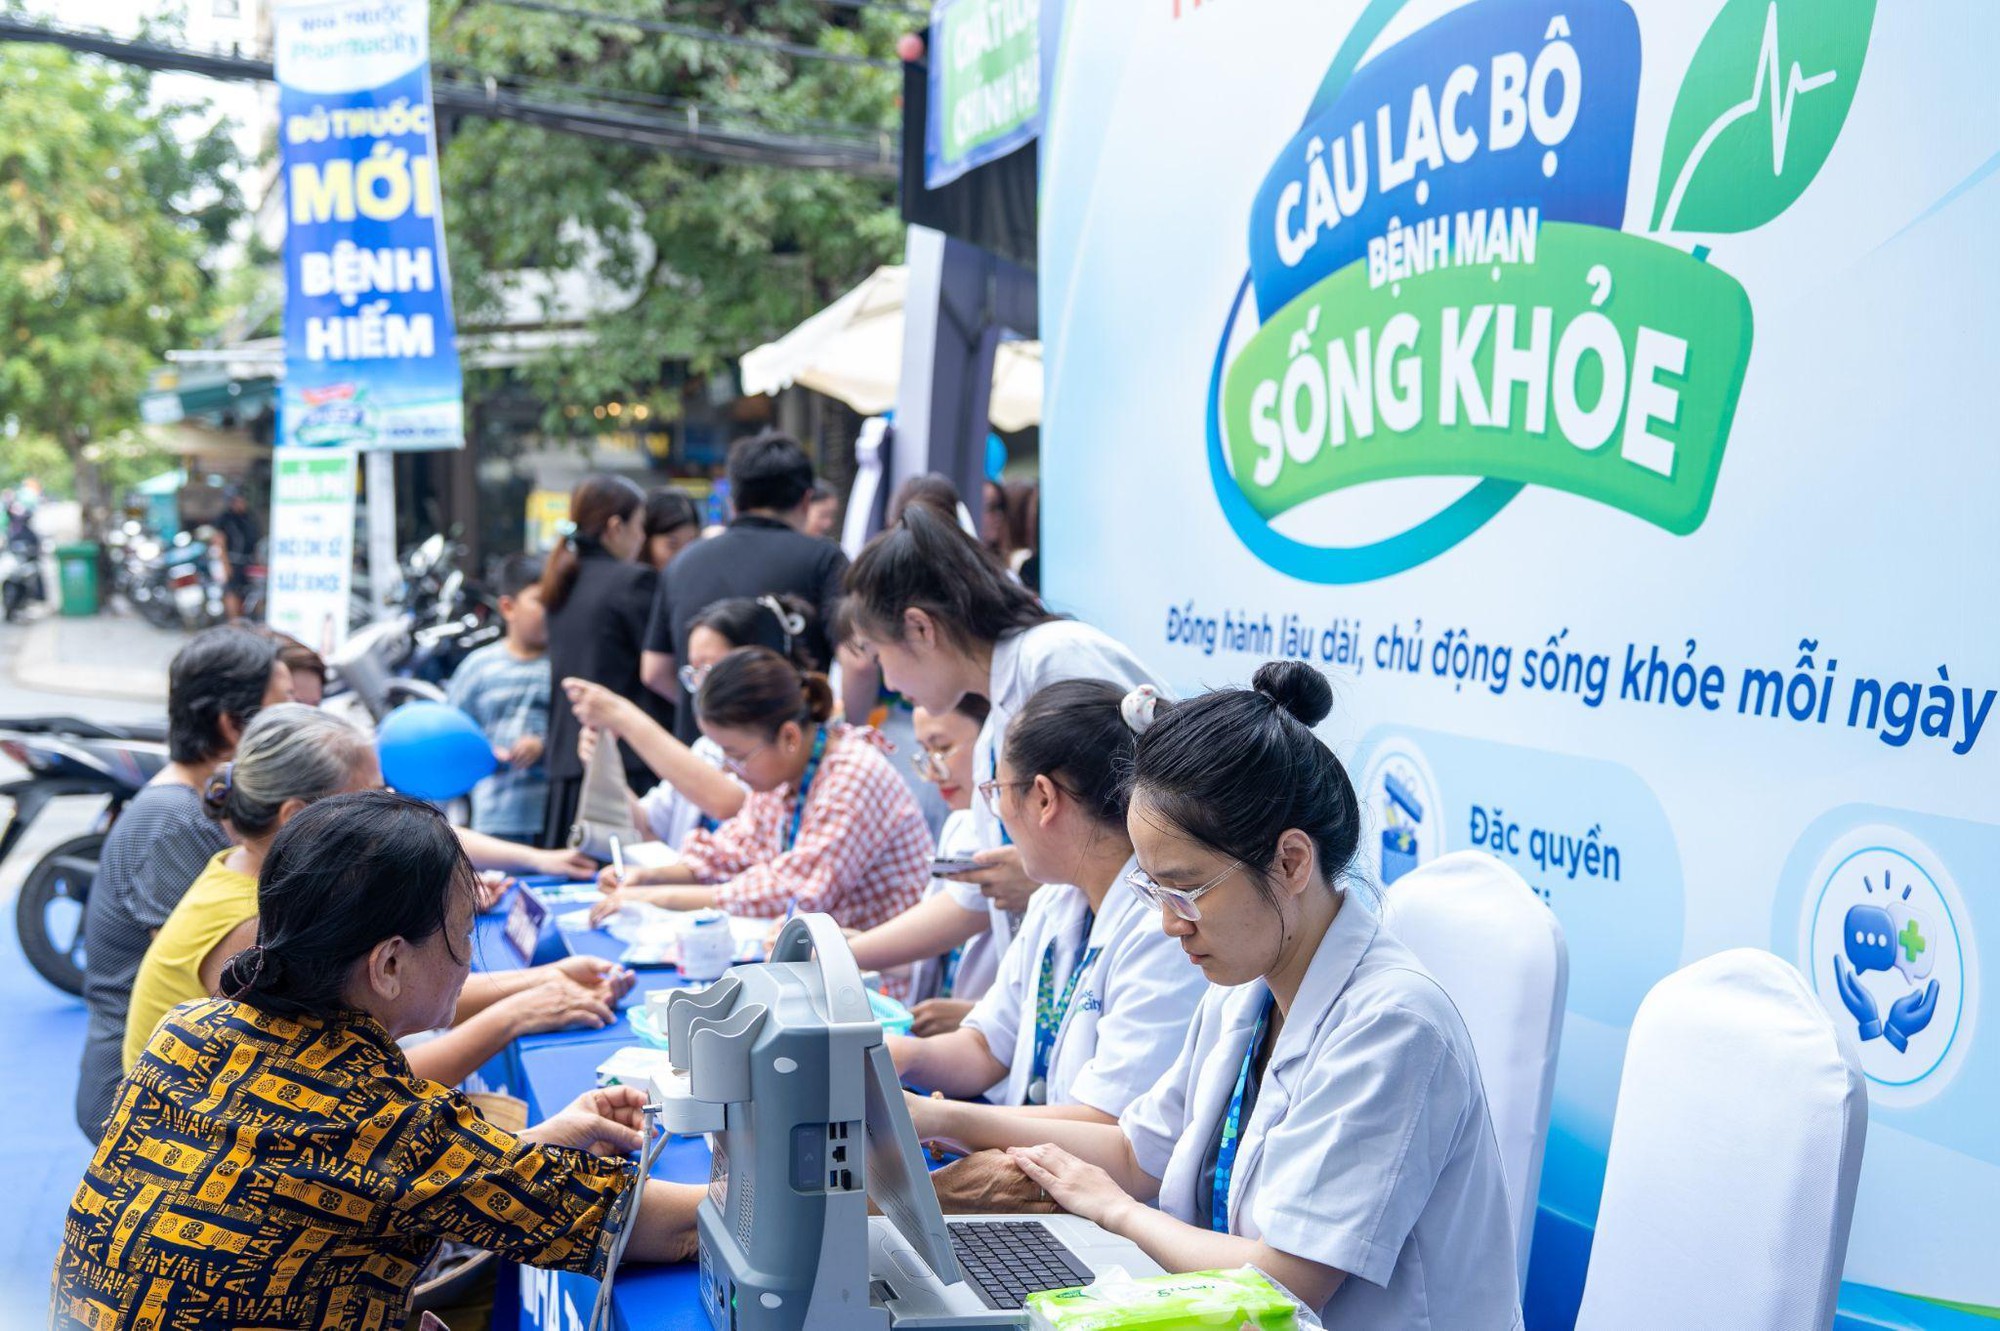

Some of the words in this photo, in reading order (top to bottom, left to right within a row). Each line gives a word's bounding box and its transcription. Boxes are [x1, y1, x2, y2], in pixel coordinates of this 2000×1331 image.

[291, 140, 434, 225] MỚI
[1274, 120, 1369, 268] CÂU
[1376, 63, 1480, 206] LẠC
[1488, 14, 1582, 179] BỘ
[301, 239, 436, 307] BỆNH
[1367, 215, 1450, 299] BỆNH
[1454, 206, 1539, 284] MẠN
[306, 299, 436, 361] HIẾM
[1249, 303, 1423, 488] SỐNG
[1438, 264, 1689, 478] KHỎE
[1222, 608, 1273, 656] hành
[1279, 612, 1315, 658] lâu
[1321, 618, 1363, 675] dài,
[1375, 618, 1423, 672] chủ
[1432, 627, 1513, 695] động
[1521, 627, 1610, 707] sống
[1620, 638, 1726, 711] khỏe
[1738, 638, 1837, 724] mỗi
[1847, 664, 1998, 756] ngày
[1529, 823, 1621, 882] quyền
